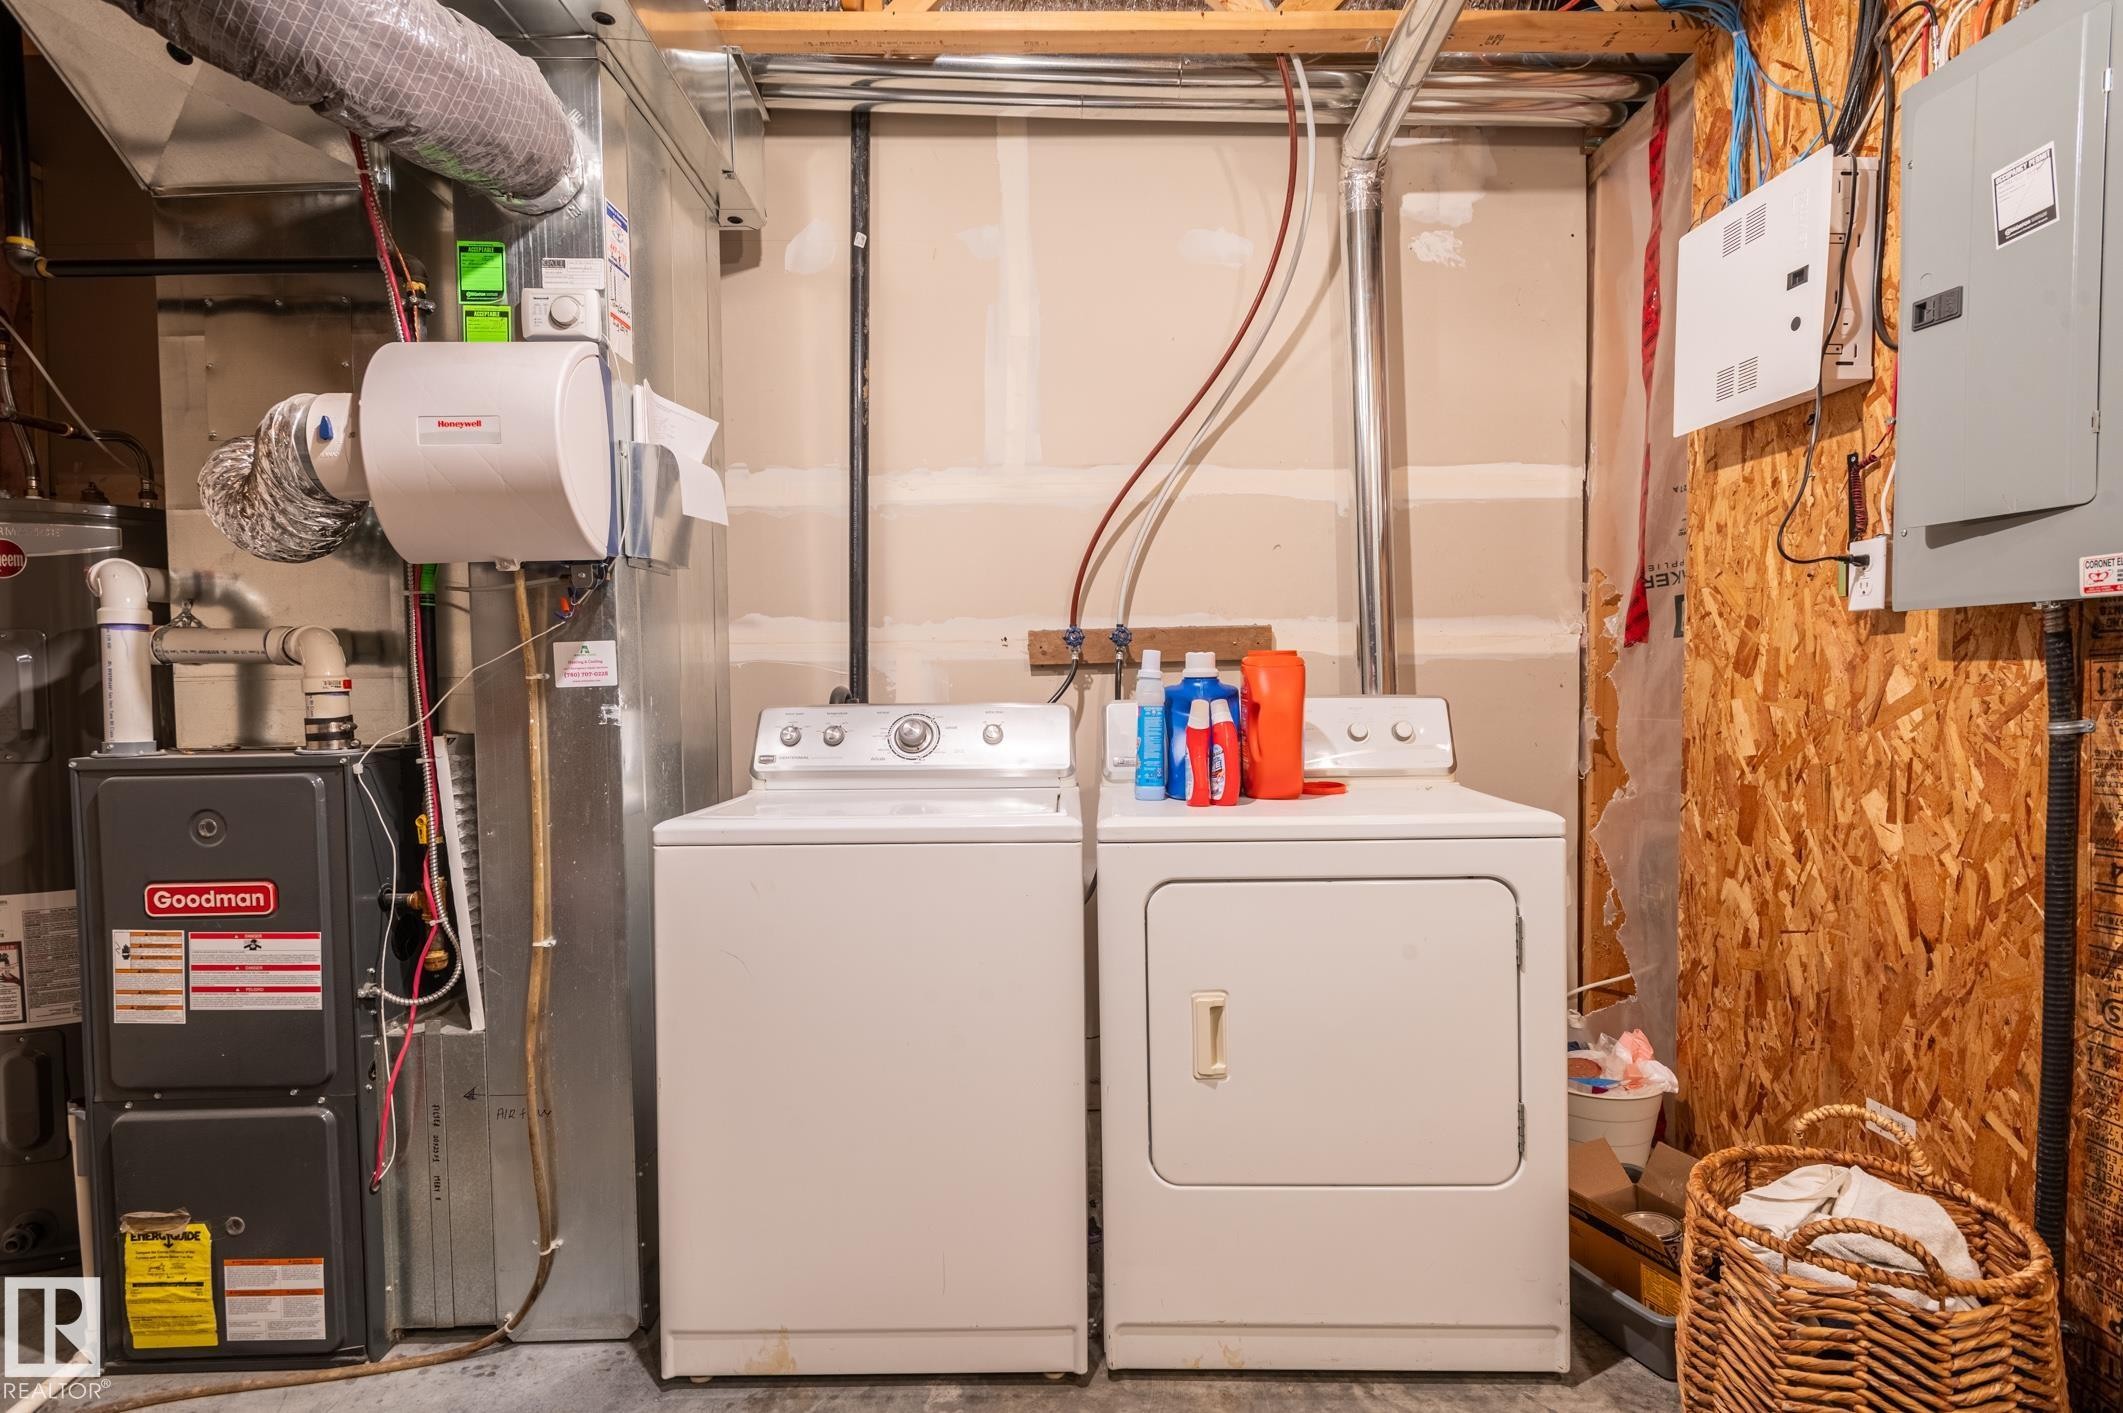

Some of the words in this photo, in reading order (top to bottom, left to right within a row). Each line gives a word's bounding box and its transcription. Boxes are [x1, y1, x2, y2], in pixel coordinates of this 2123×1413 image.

[437, 419, 482, 429] Honeywell
[2085, 558, 2115, 569] CORONET
[152, 890, 265, 909] Goodman
[496, 1107, 516, 1121] AIR
